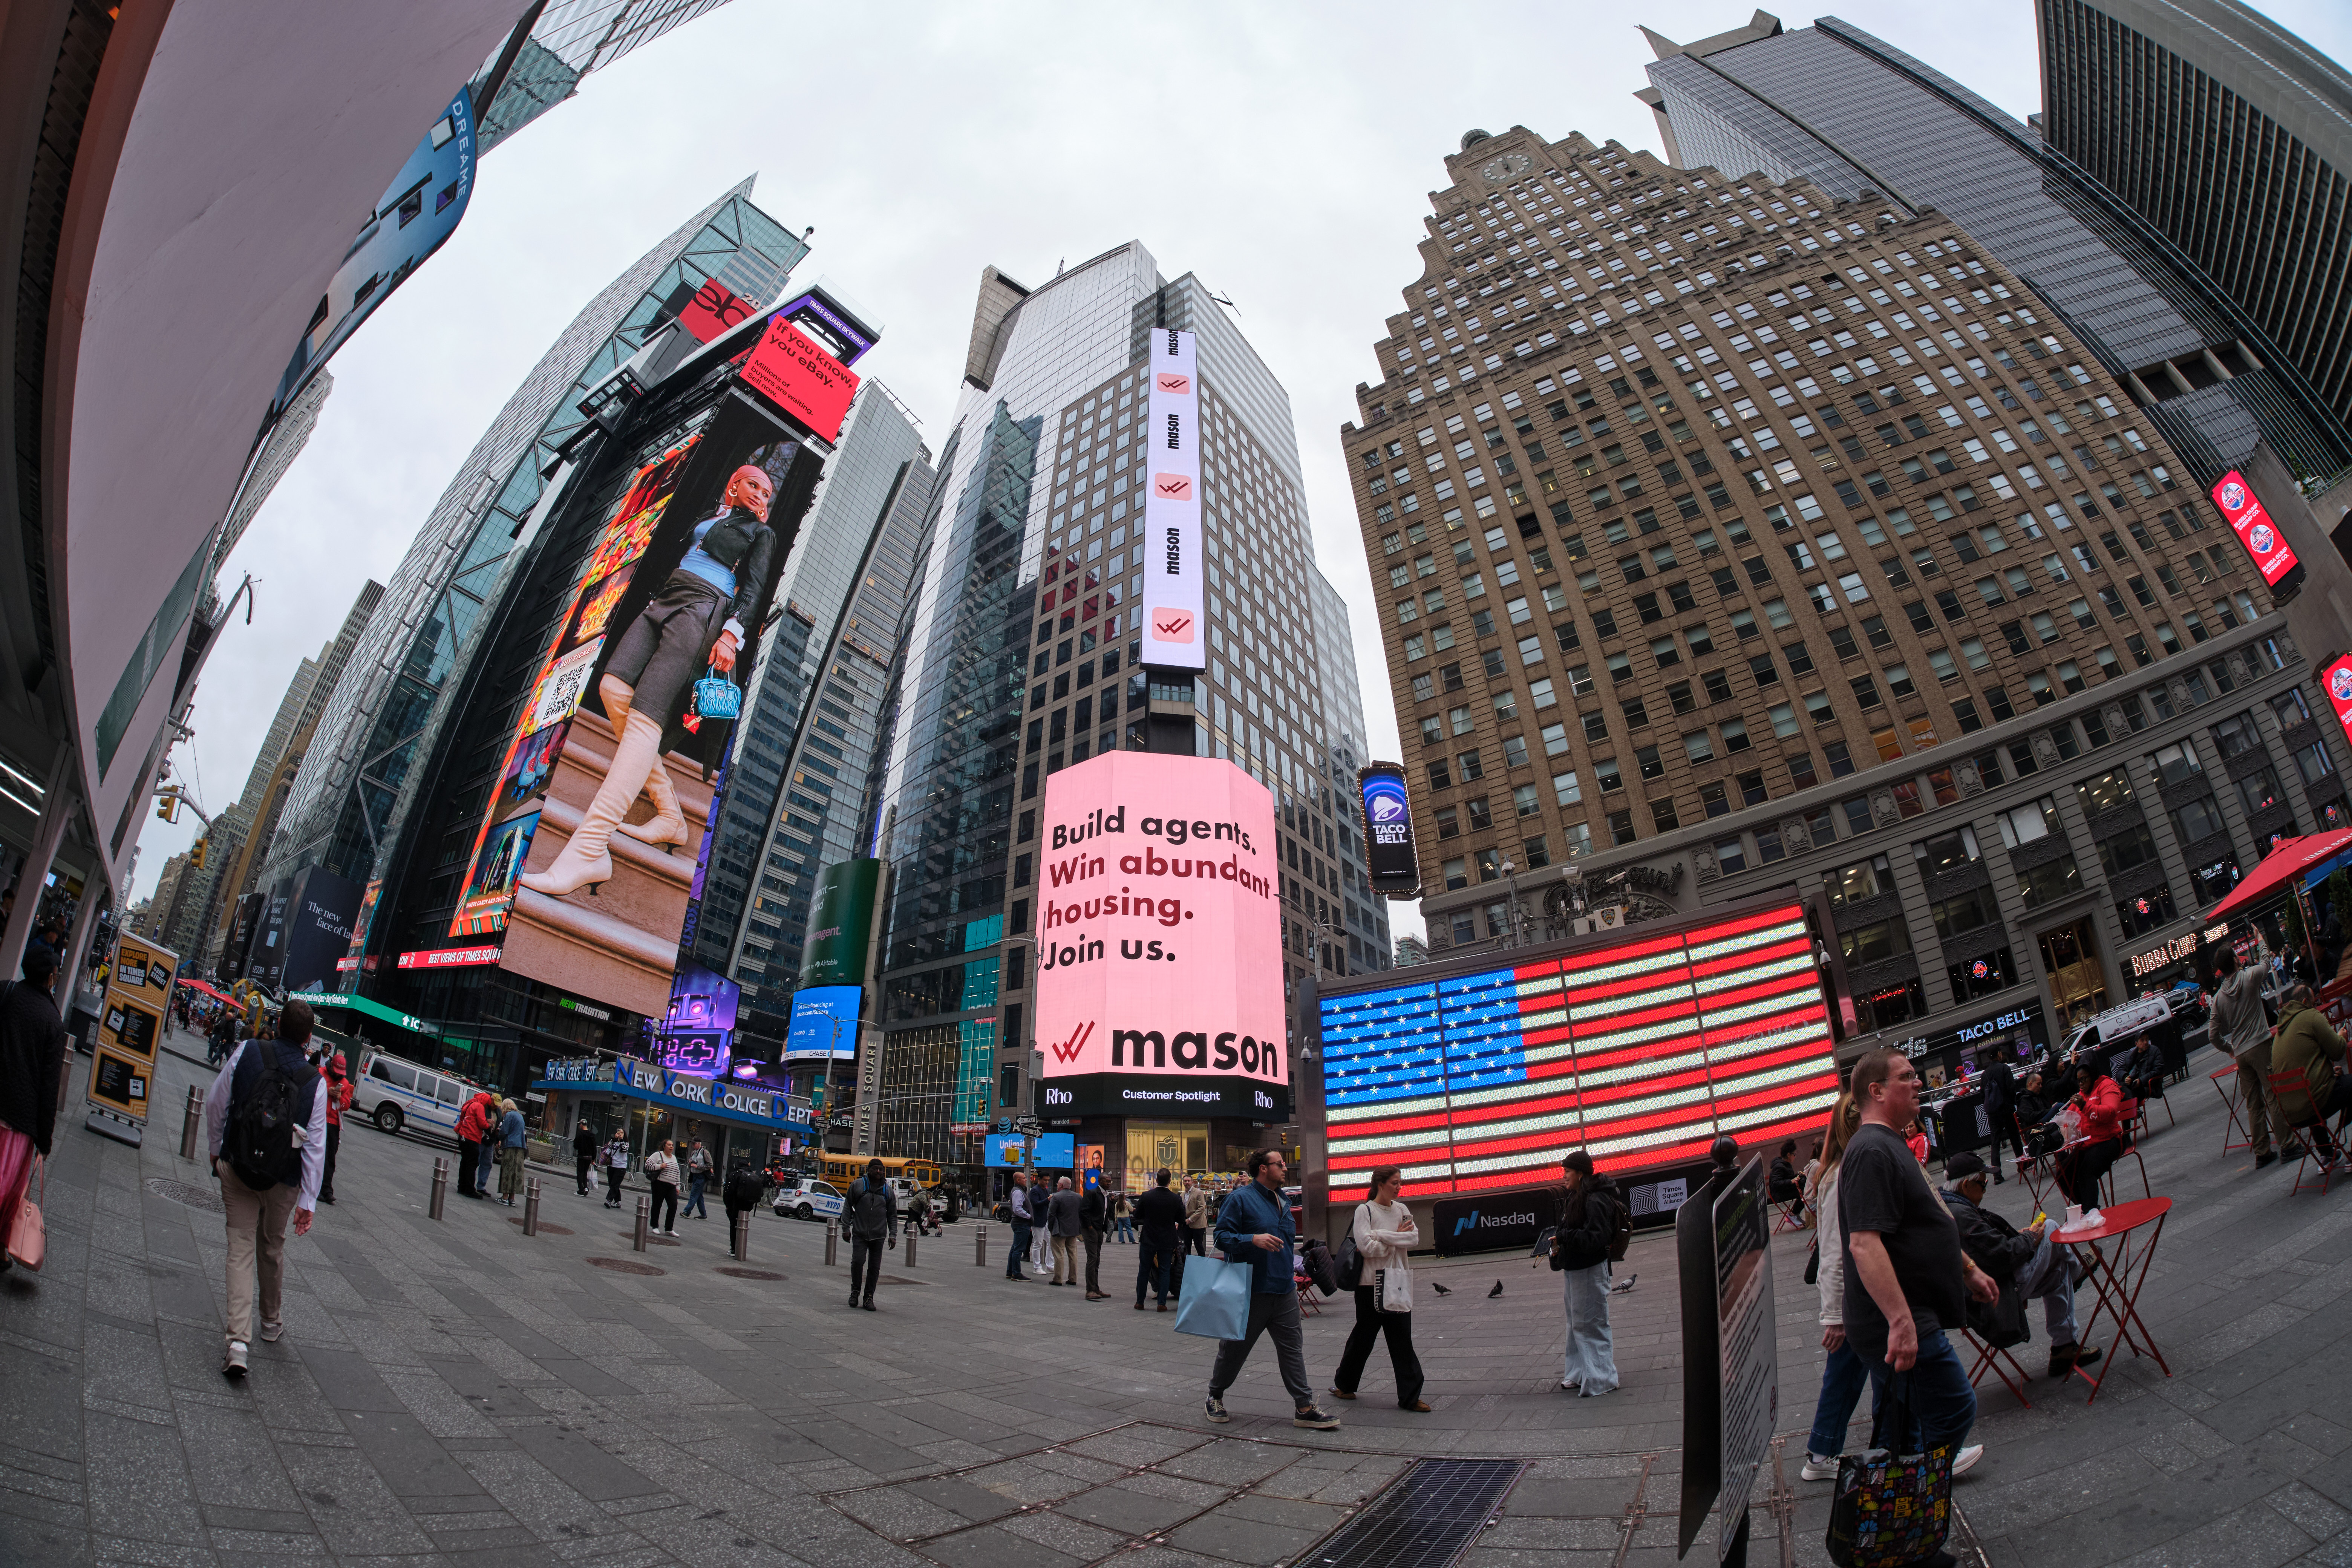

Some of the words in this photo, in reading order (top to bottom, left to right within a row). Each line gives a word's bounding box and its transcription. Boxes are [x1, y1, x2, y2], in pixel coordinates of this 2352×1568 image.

[452, 101, 470, 199] DREAME
[809, 300, 824, 314] TIMES
[823, 310, 843, 328] SQUARE
[841, 325, 865, 347] SKYWALK
[770, 334, 796, 357] you
[798, 356, 833, 388] eBay.
[776, 322, 788, 334] If
[789, 332, 813, 355] you
[816, 352, 852, 388] know,
[754, 359, 781, 382] Millions
[782, 380, 791, 388] of
[747, 372, 761, 385] Sell
[761, 383, 777, 397] now.
[750, 366, 775, 386] buyers
[775, 385, 787, 395] are
[788, 394, 813, 415] waiting.
[1168, 414, 1179, 449] mason
[2234, 514, 2248, 528] BUBBA
[2246, 503, 2258, 515] GUMP
[2238, 515, 2253, 531] SHRIMP
[1167, 527, 1180, 575] mason
[2262, 558, 2277, 572] BUBBA
[2275, 547, 2287, 559] GUMP
[2266, 559, 2282, 575] SHRIMP
[559, 657, 573, 669] BUY
[573, 643, 599, 662] TICKETS
[1052, 805, 1125, 850] Build
[1141, 817, 1256, 855] agents.
[1372, 824, 1406, 834] TACO
[1376, 834, 1407, 844] BELL
[2301, 846, 2332, 861] TIMES
[1050, 853, 1105, 888] Win
[1119, 847, 1269, 900] abundant
[308, 901, 323, 915] The
[323, 910, 341, 922] new
[813, 899, 824, 914] and
[1047, 886, 1193, 929] housing.
[316, 917, 333, 931] face
[334, 926, 344, 936] of
[120, 957, 138, 967] MORE
[121, 948, 147, 961] EXPLORE
[428, 954, 439, 964] BEST
[440, 952, 456, 963] VIEWS
[456, 952, 465, 962] OF
[465, 949, 481, 961] TIMES
[1044, 934, 1104, 970] Join
[1121, 939, 1176, 962] us.
[2131, 946, 2170, 977] BUBBA
[2167, 933, 2197, 960] GUMP
[119, 973, 143, 986] SQUARE
[120, 965, 127, 973] IN
[127, 966, 145, 978] TIMES
[150, 971, 167, 986] STREET
[153, 966, 165, 977] 43RD
[253, 966, 265, 975] LEGORA
[329, 994, 340, 1003] Tickets
[340, 995, 348, 1004] Here
[559, 998, 610, 1021] NEWTRADITION
[1957, 1021, 1994, 1043] TACO
[1997, 1009, 2030, 1030] BELL
[1977, 1034, 2005, 1047] cantina
[1112, 1029, 1278, 1077] mason
[545, 1061, 554, 1081] NEW
[554, 1061, 566, 1081] YORK
[566, 1060, 581, 1081] POLICE
[581, 1059, 599, 1081] DEPT
[864, 1041, 876, 1092] SQUARE
[614, 1057, 659, 1091] NEW
[662, 1069, 707, 1104] YORK
[711, 1082, 767, 1116] POLICE
[772, 1096, 814, 1125] DEPT
[1046, 1088, 1072, 1104] Rho
[1122, 1090, 1174, 1099] Customer
[1175, 1091, 1220, 1102] Spotlight
[1255, 1090, 1273, 1109] Rho
[828, 1118, 854, 1127] HASE
[859, 1104, 870, 1143] TIMES
[1000, 1138, 1037, 1149] Unlimit
[825, 1200, 841, 1210] NYPD
[1481, 1212, 1535, 1228] Nasdaq
